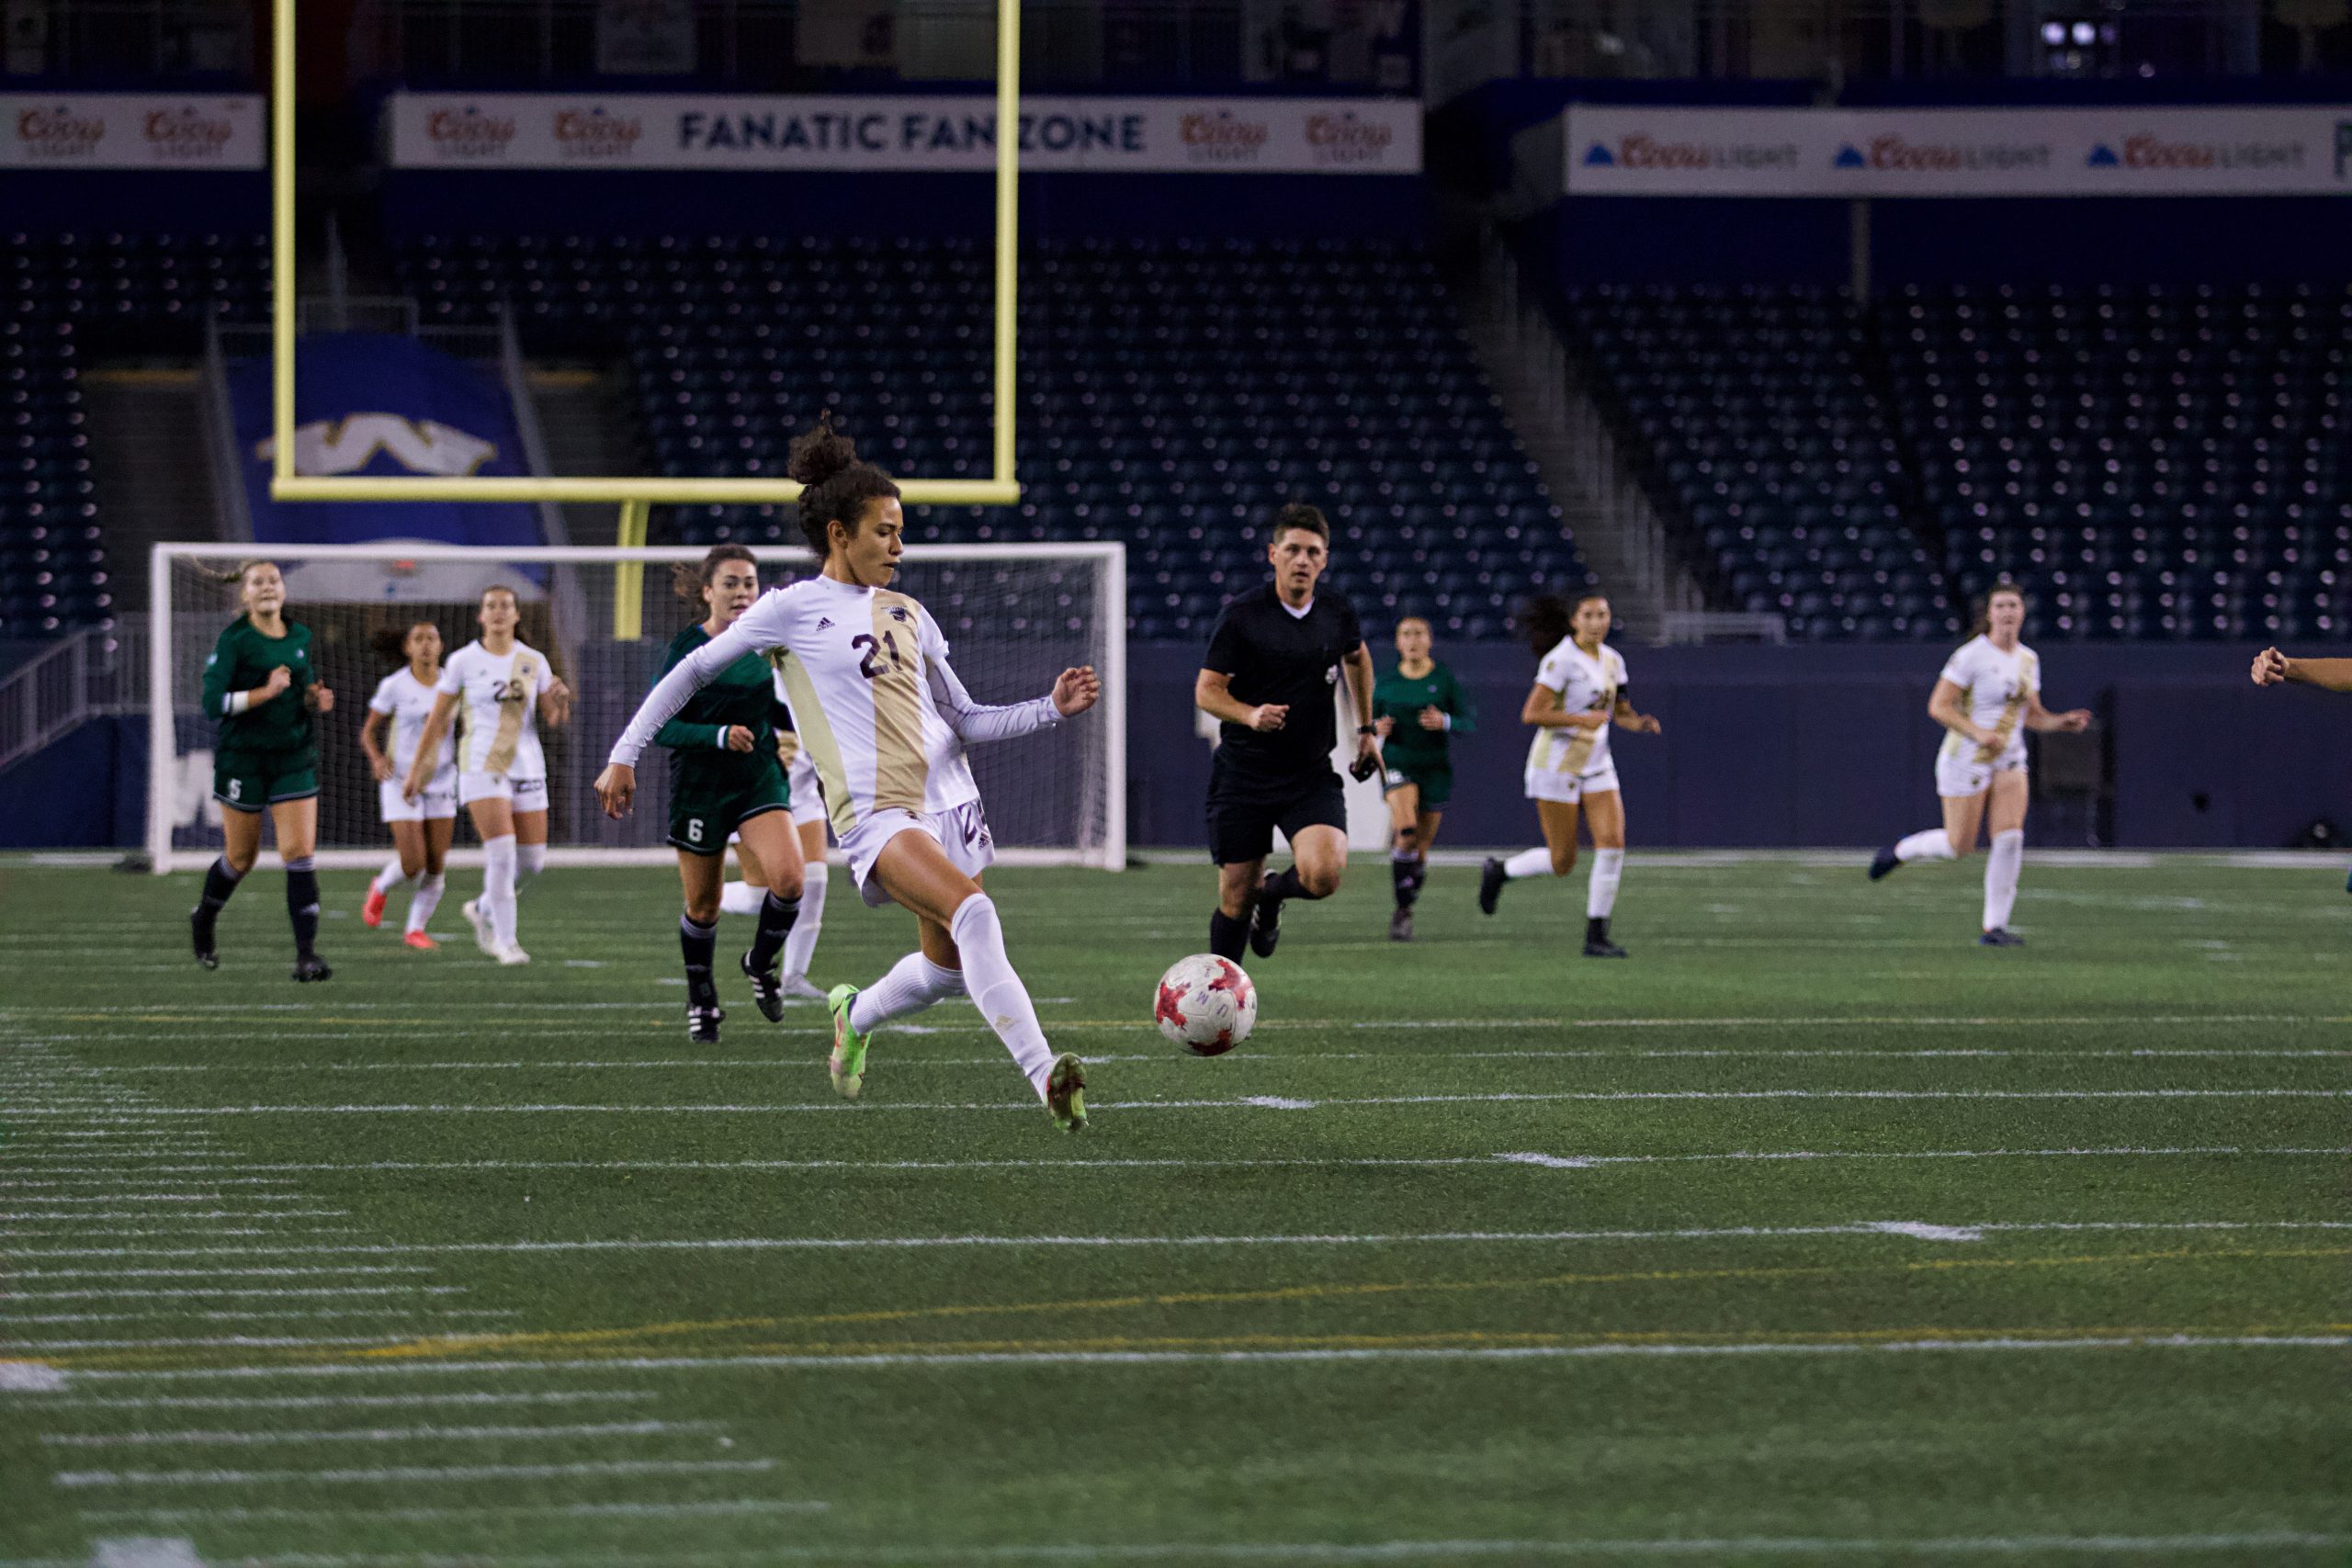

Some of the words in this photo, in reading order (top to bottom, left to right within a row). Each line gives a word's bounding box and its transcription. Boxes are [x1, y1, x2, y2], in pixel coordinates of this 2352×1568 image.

[679, 111, 888, 151] FANATIC
[851, 630, 903, 678] 21
[688, 818, 704, 842] 6
